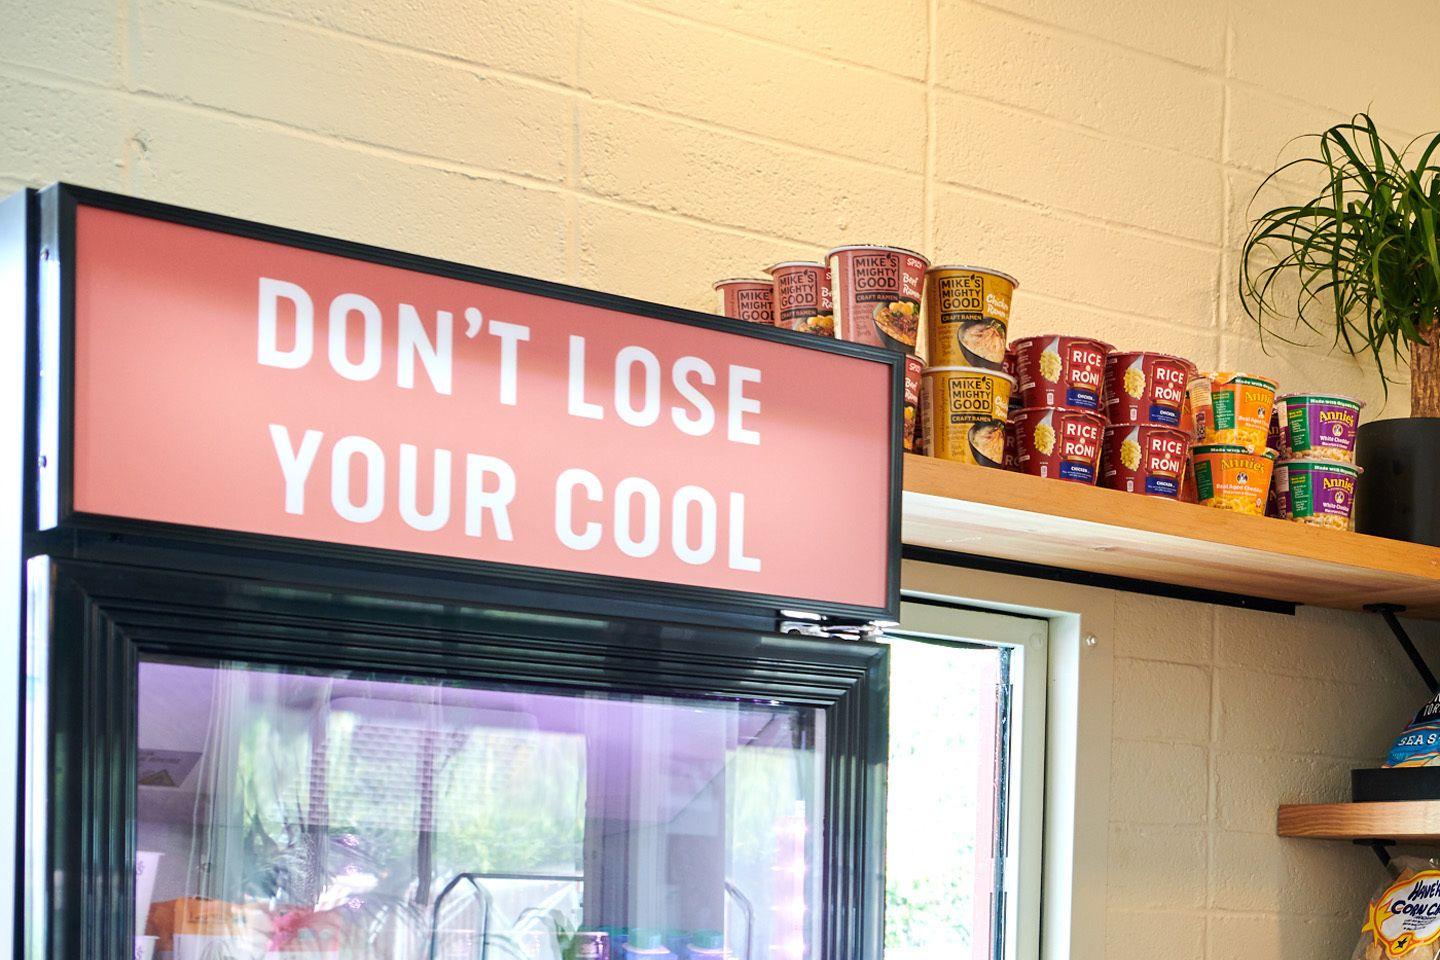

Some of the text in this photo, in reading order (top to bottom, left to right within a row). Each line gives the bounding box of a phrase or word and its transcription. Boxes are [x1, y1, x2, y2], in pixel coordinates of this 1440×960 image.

[856, 254, 897, 268] MIKE'S
[857, 268, 897, 278] MIGHTY
[858, 276, 897, 288] GOOD
[941, 276, 981, 289] MIKE'S
[878, 293, 898, 301] RAMEN
[942, 288, 980, 298] MIGHTY
[942, 297, 980, 309] GOOD
[257, 277, 763, 445] DON'T LOSE
[1073, 350, 1102, 367] RICE
[1072, 369, 1100, 385] RONI
[1156, 368, 1185, 384] RICE
[952, 378, 990, 391] MIKE'S
[952, 390, 991, 400] MIGHTY
[1154, 387, 1182, 403] RONI
[953, 399, 990, 411] GOOD
[1319, 410, 1354, 426] Annie's
[1066, 423, 1097, 440] RICE
[1065, 442, 1095, 458] RONI
[1323, 478, 1354, 494] Annie's
[268, 425, 763, 573] YOUR COOL
[1398, 734, 1424, 747] SEA
[1390, 900, 1426, 916] CORN
